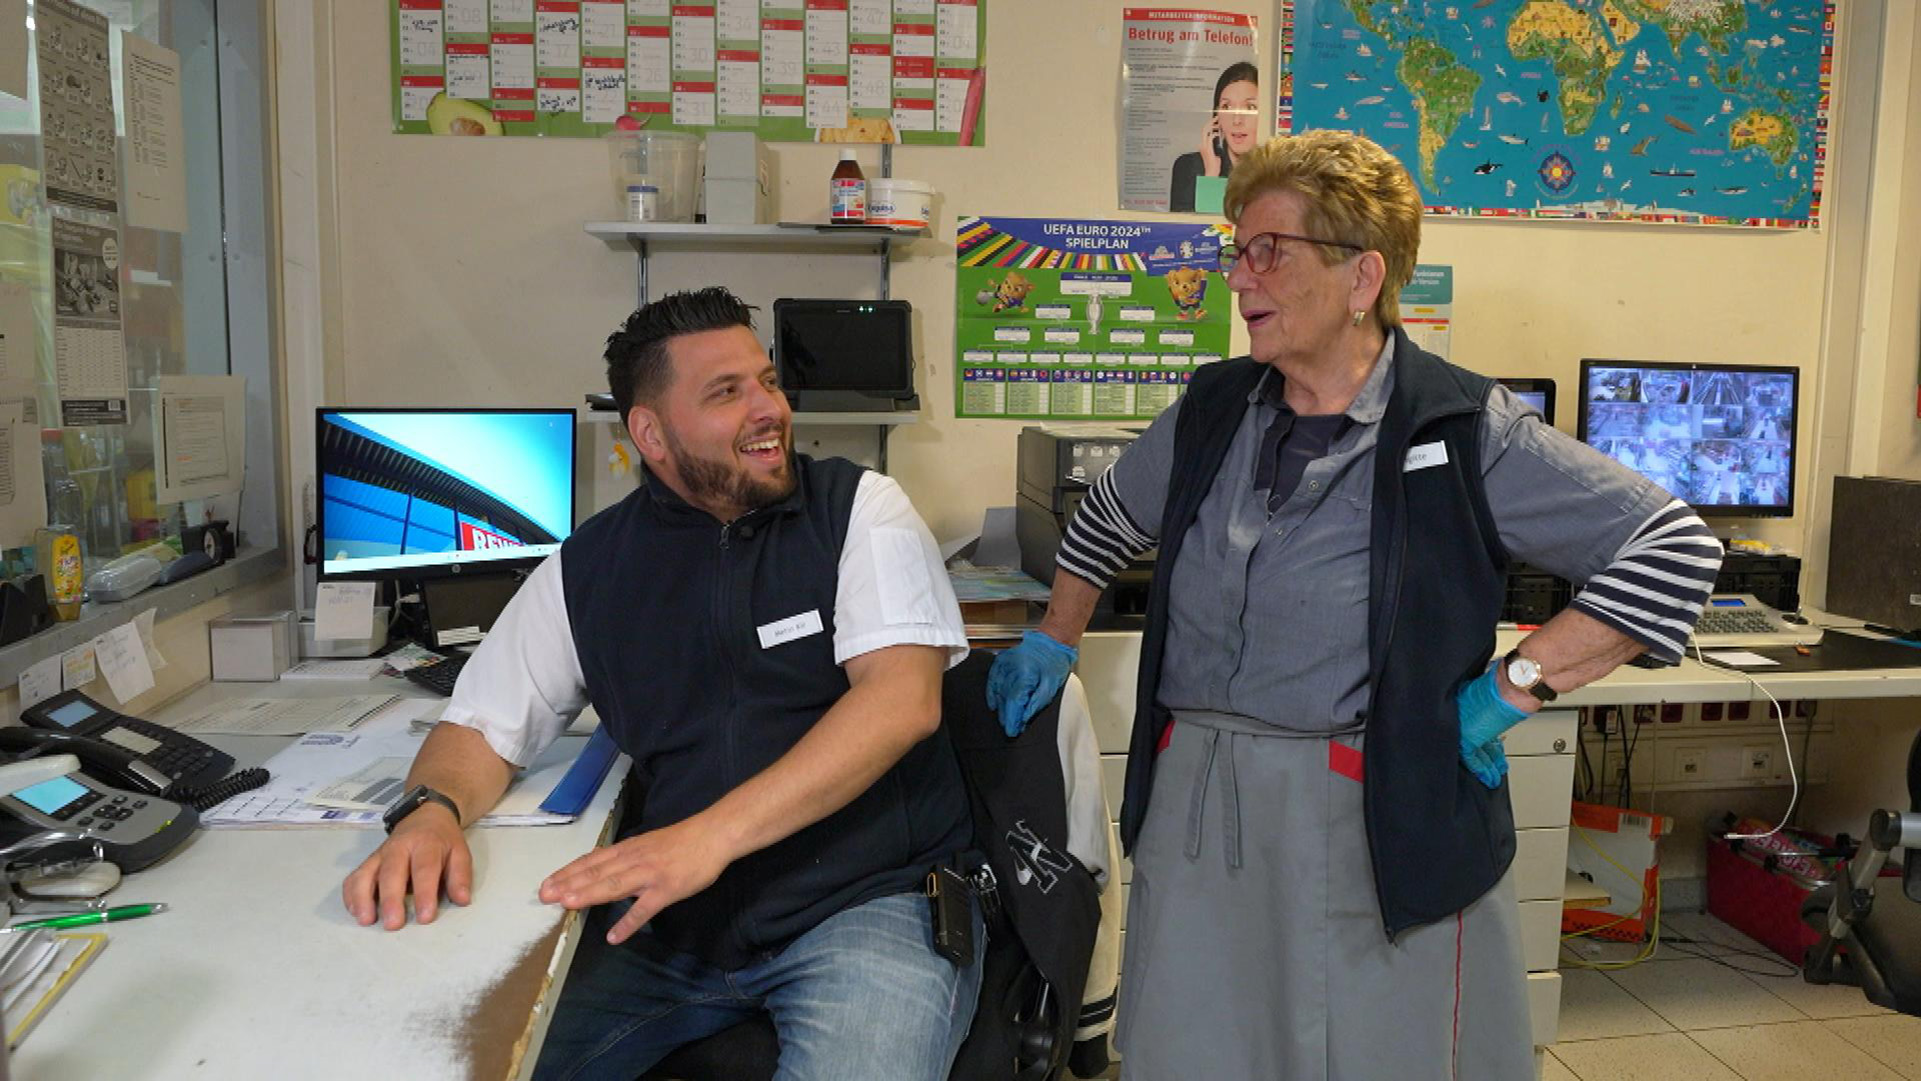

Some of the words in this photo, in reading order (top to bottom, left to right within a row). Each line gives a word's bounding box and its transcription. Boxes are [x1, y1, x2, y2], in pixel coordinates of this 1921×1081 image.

[1128, 27, 1175, 44] Betrug
[1179, 30, 1199, 42] am
[1204, 29, 1254, 46] Telefon!
[1044, 223, 1076, 236] UEFA
[1077, 225, 1109, 236] EURO
[1065, 237, 1130, 249] SPIELPLAN
[472, 528, 522, 550] REW
